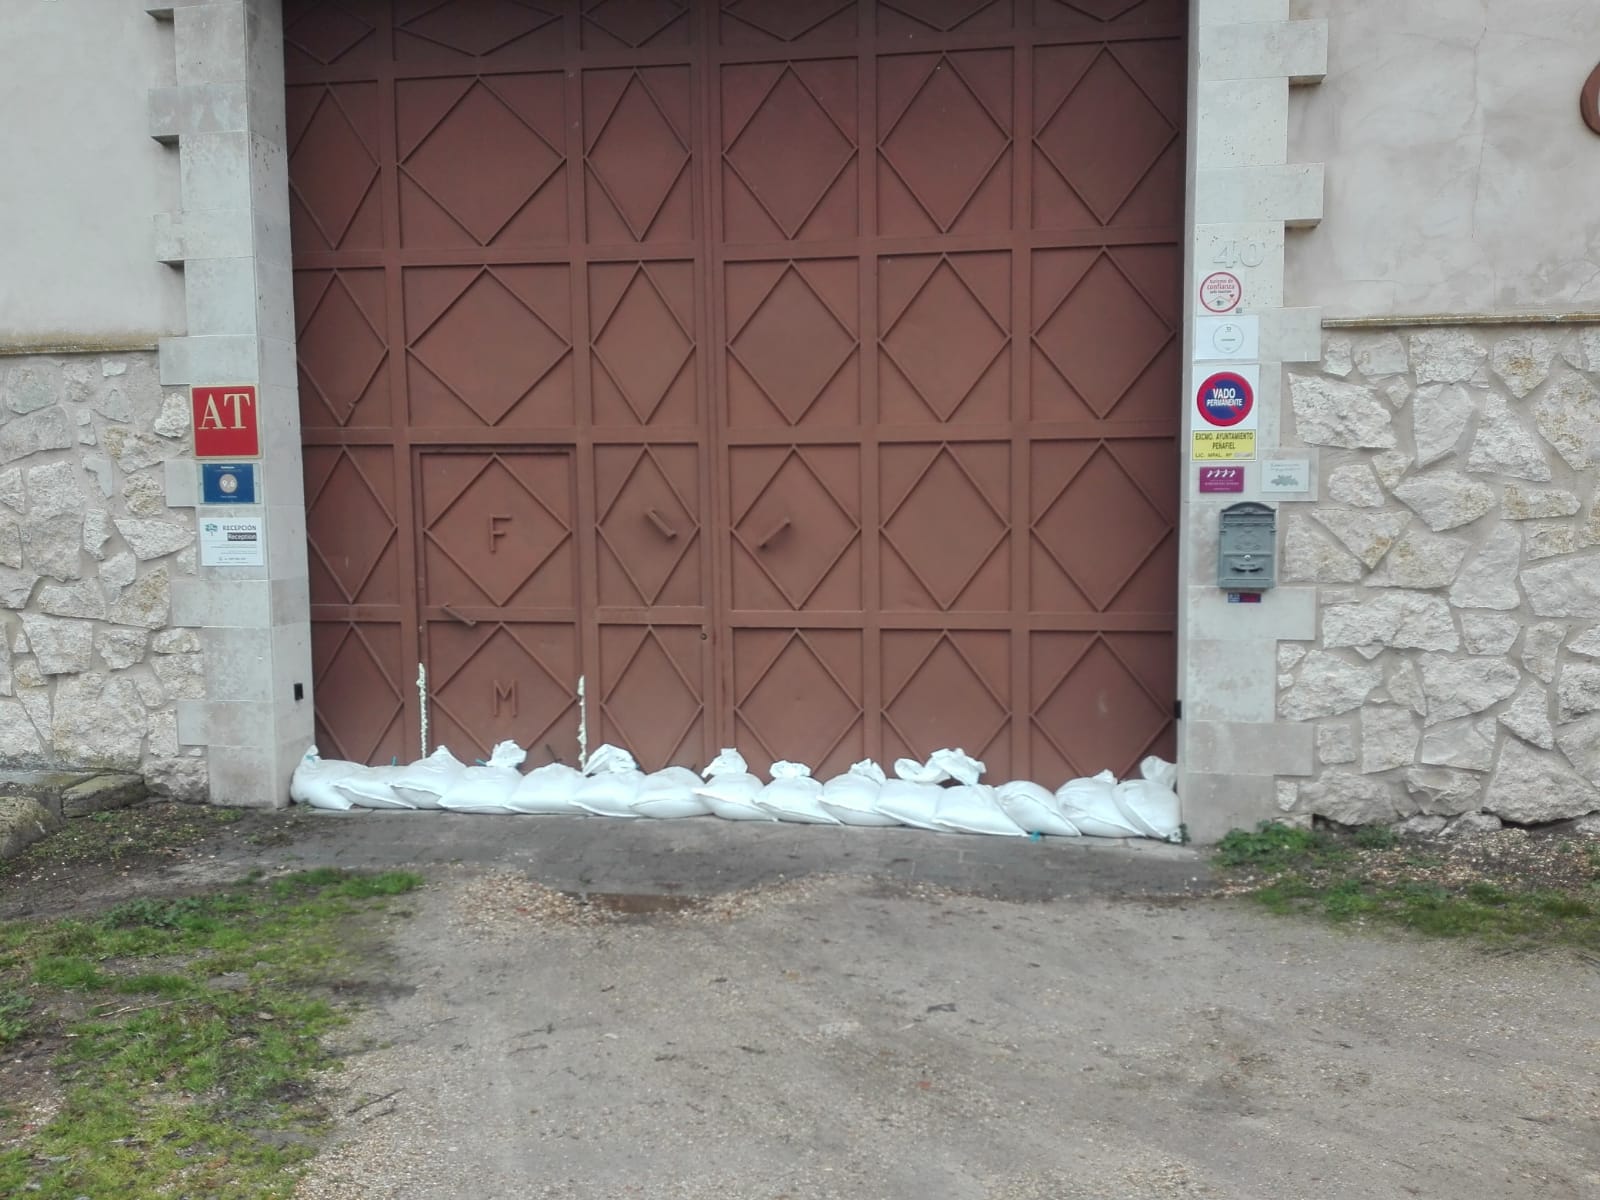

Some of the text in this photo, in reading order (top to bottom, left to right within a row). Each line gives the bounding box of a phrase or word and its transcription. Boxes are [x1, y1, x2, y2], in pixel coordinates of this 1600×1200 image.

[1213, 240, 1265, 268] 40
[1206, 398, 1243, 407] PERMANENTE
[1212, 388, 1236, 399] VADO
[198, 393, 251, 430] AT
[1216, 432, 1253, 440] AYUNTAMIENTO
[222, 523, 256, 531] RECEPCIÓN
[490, 515, 512, 554] F
[494, 679, 518, 718] M
